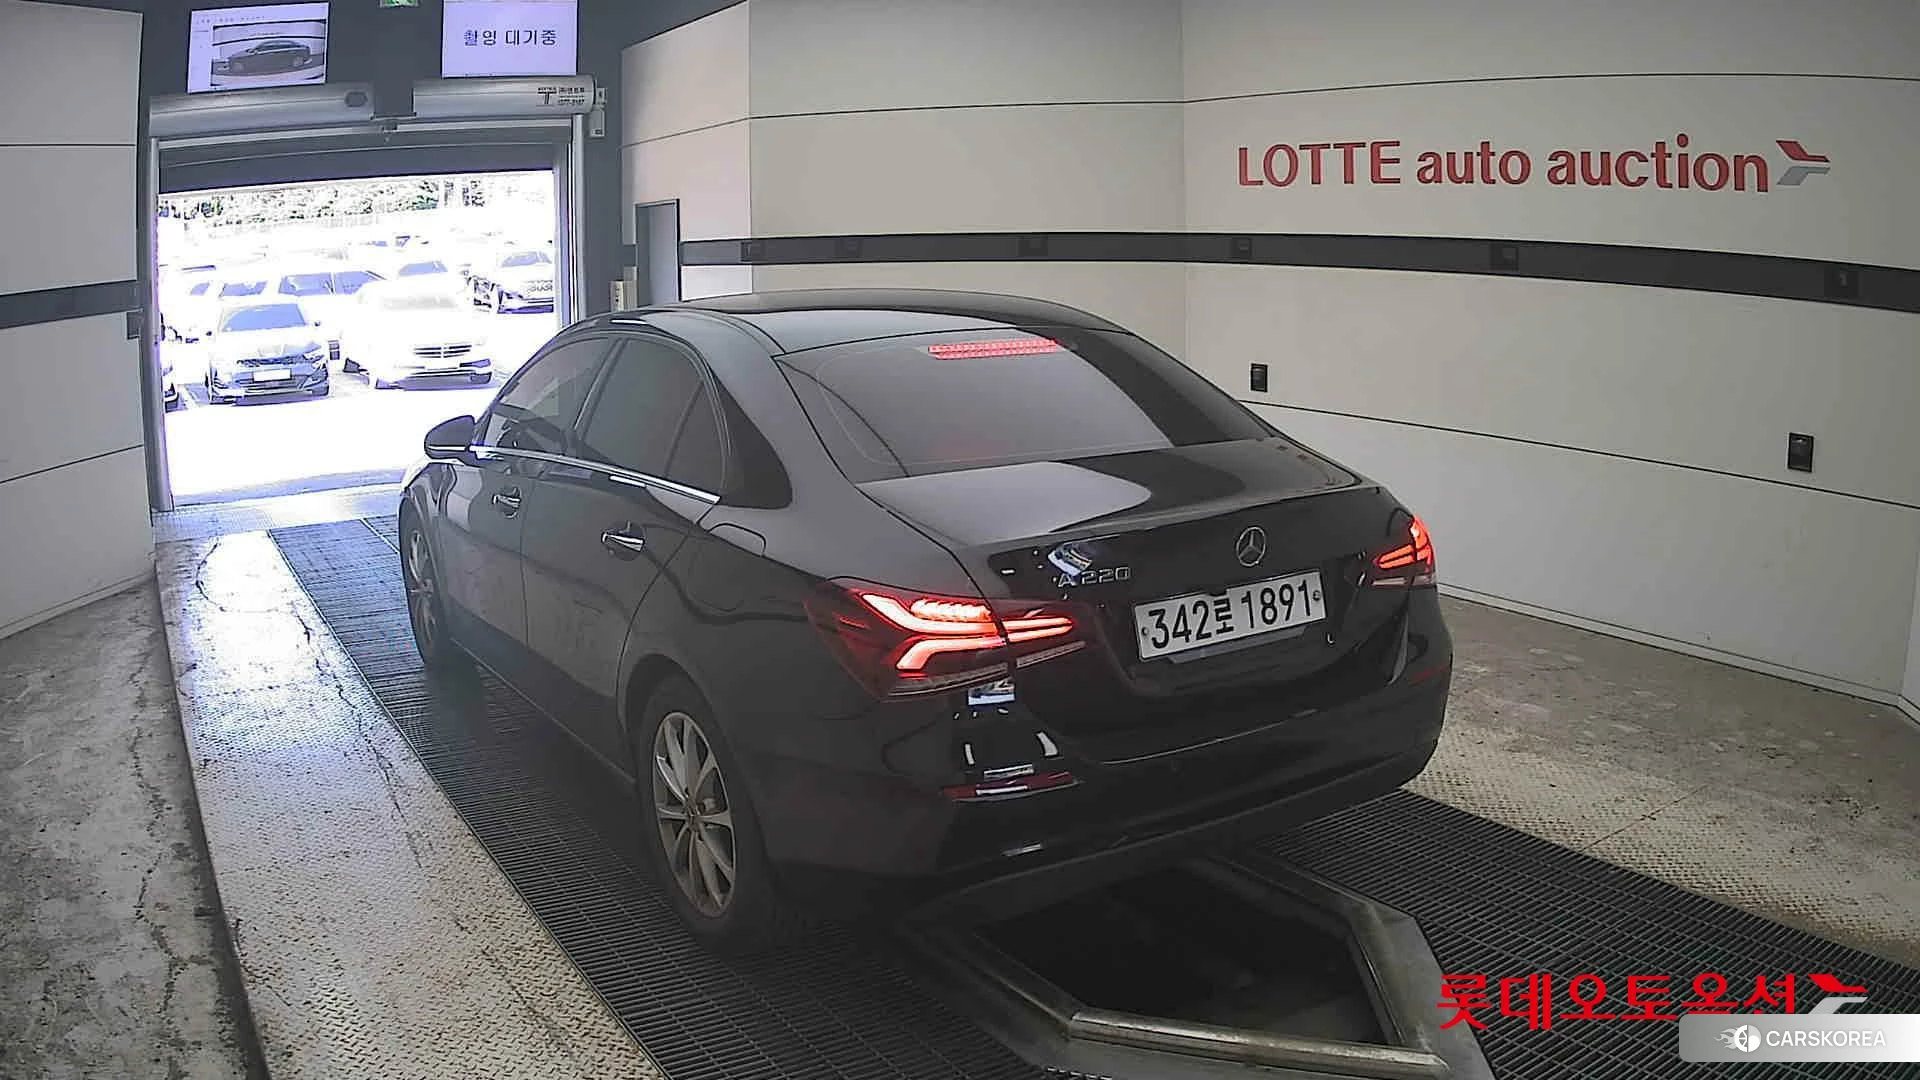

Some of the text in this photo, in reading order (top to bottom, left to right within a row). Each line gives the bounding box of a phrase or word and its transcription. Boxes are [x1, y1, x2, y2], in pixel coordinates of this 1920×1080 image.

[505, 29, 557, 46] 대기중
[1238, 133, 1769, 193] LOTTE auto auction
[1057, 566, 1131, 588] A 220
[1148, 579, 1312, 649] 342로 1891
